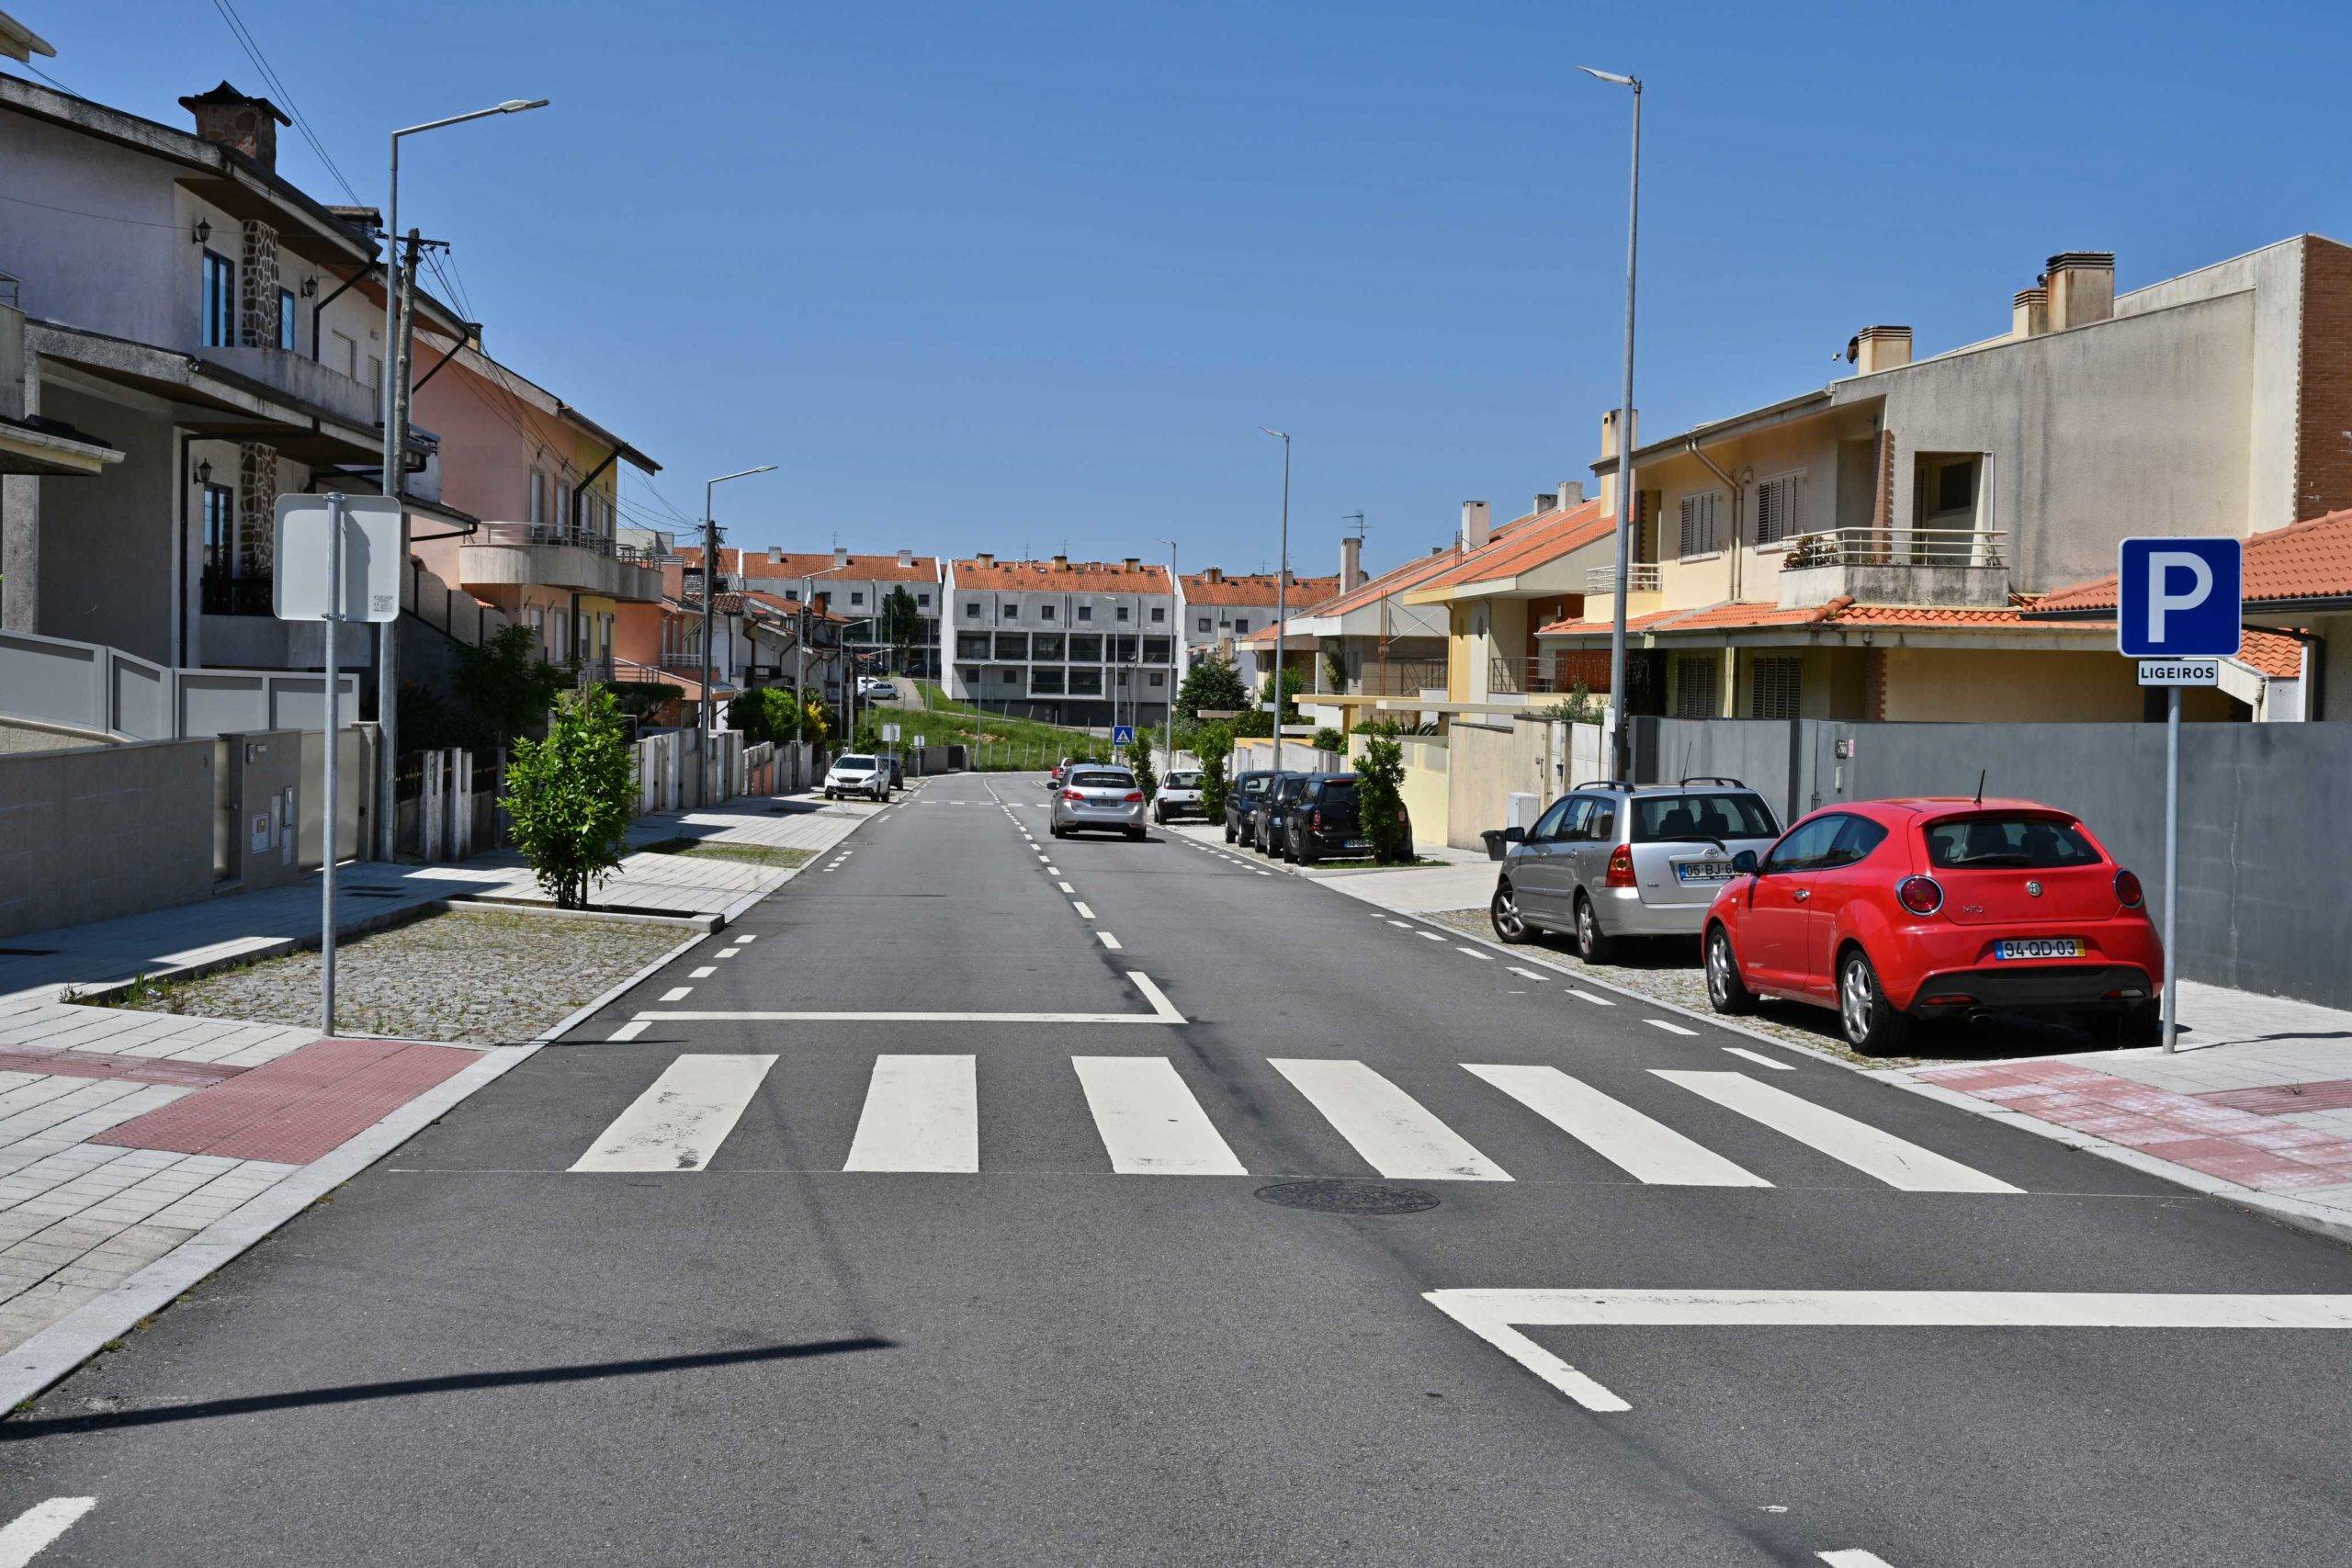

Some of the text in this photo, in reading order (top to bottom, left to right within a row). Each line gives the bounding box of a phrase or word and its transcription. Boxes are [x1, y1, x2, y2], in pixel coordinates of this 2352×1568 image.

[2148, 551, 2213, 643] P
[2141, 667, 2214, 679] LIGEIROS
[1686, 863, 1734, 876] 05-BJ-6
